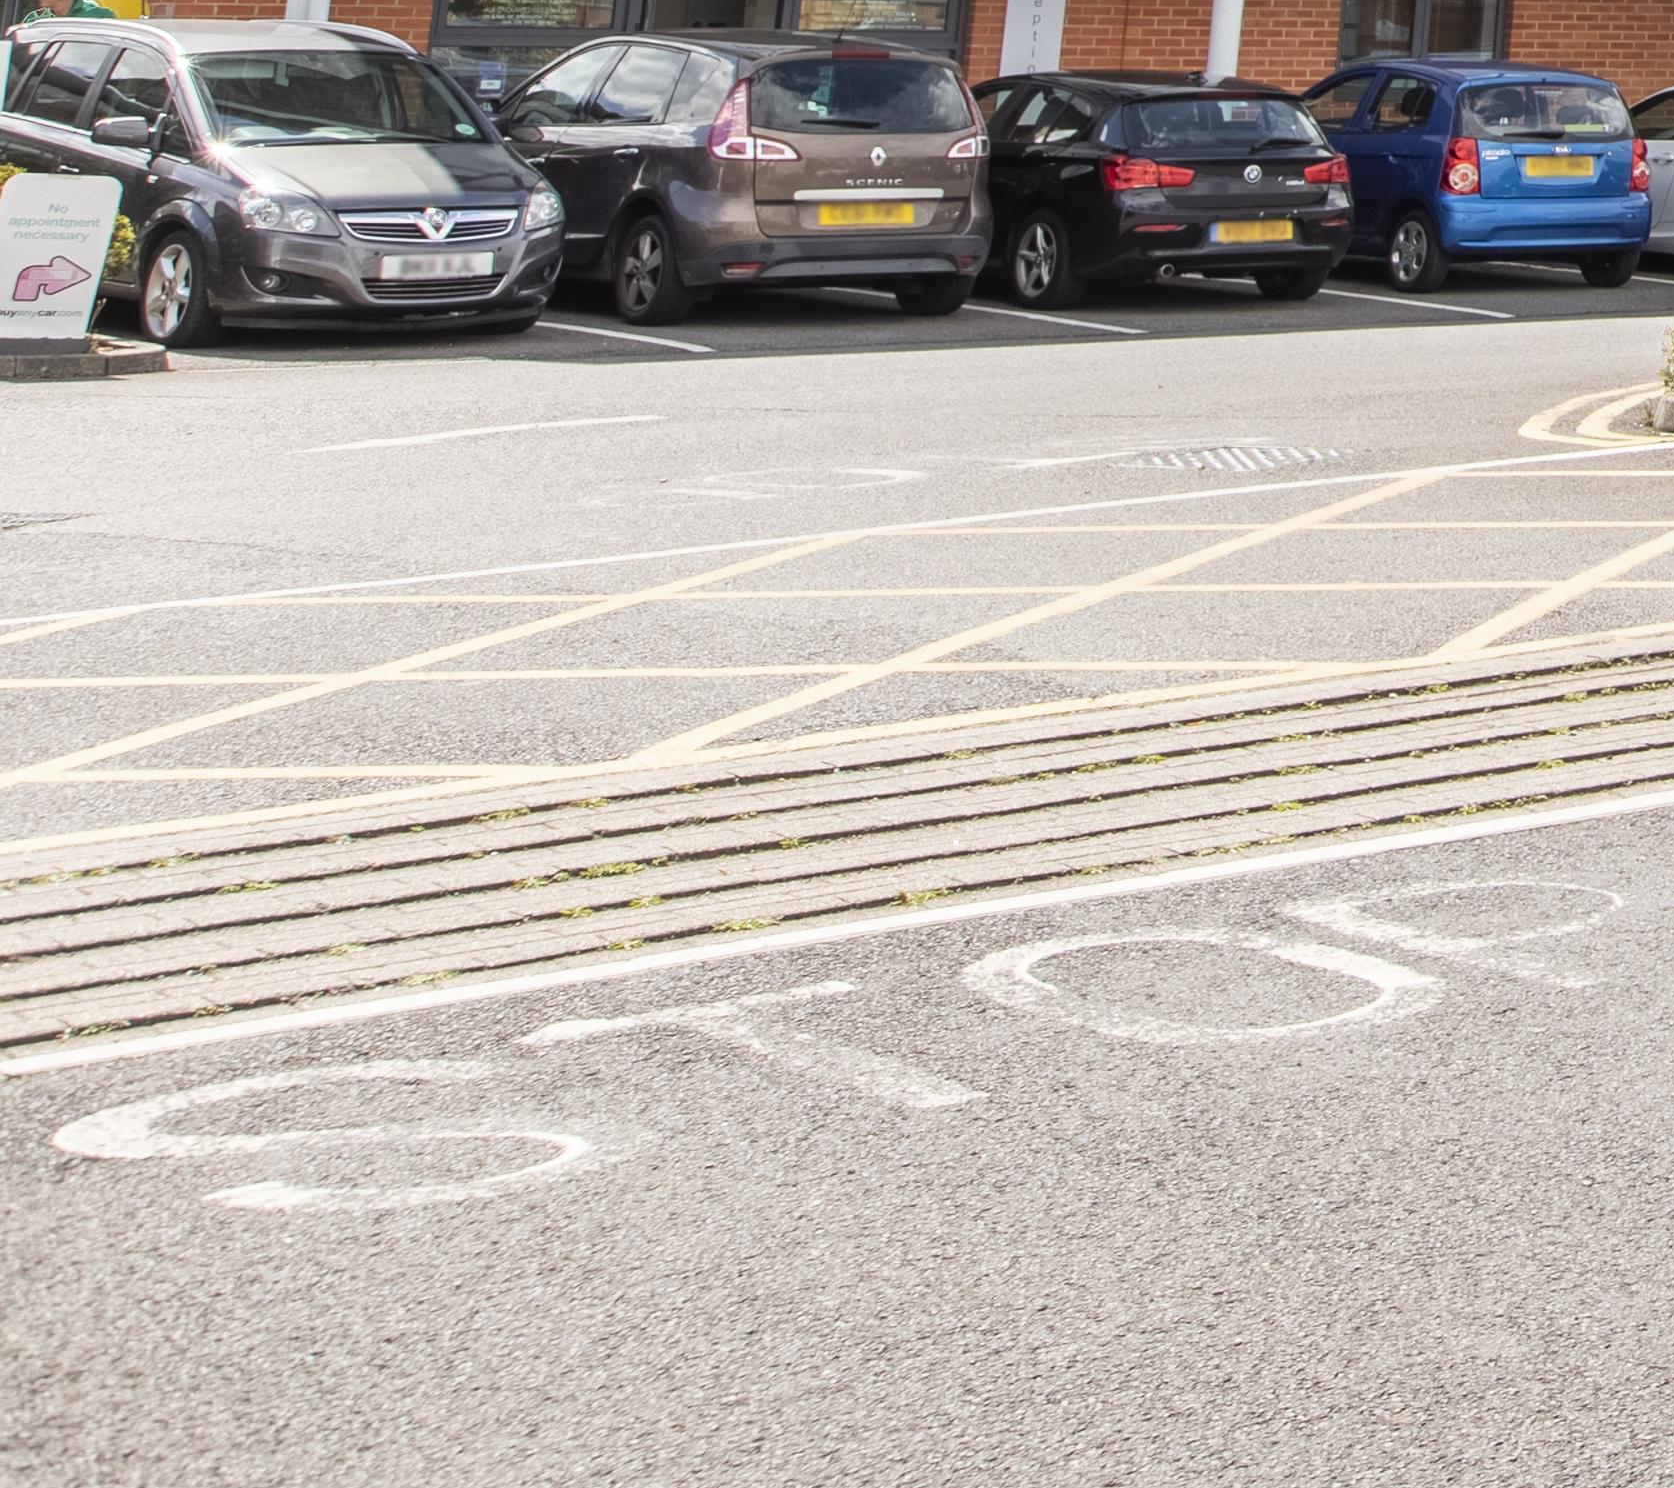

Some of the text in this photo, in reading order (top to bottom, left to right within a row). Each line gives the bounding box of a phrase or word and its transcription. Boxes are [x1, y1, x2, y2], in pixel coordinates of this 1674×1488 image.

[845, 177, 904, 187] SCENIC
[48, 203, 69, 214] No
[8, 217, 101, 229] appointment
[13, 229, 91, 244] necessary
[48, 875, 1628, 1213] STOP
